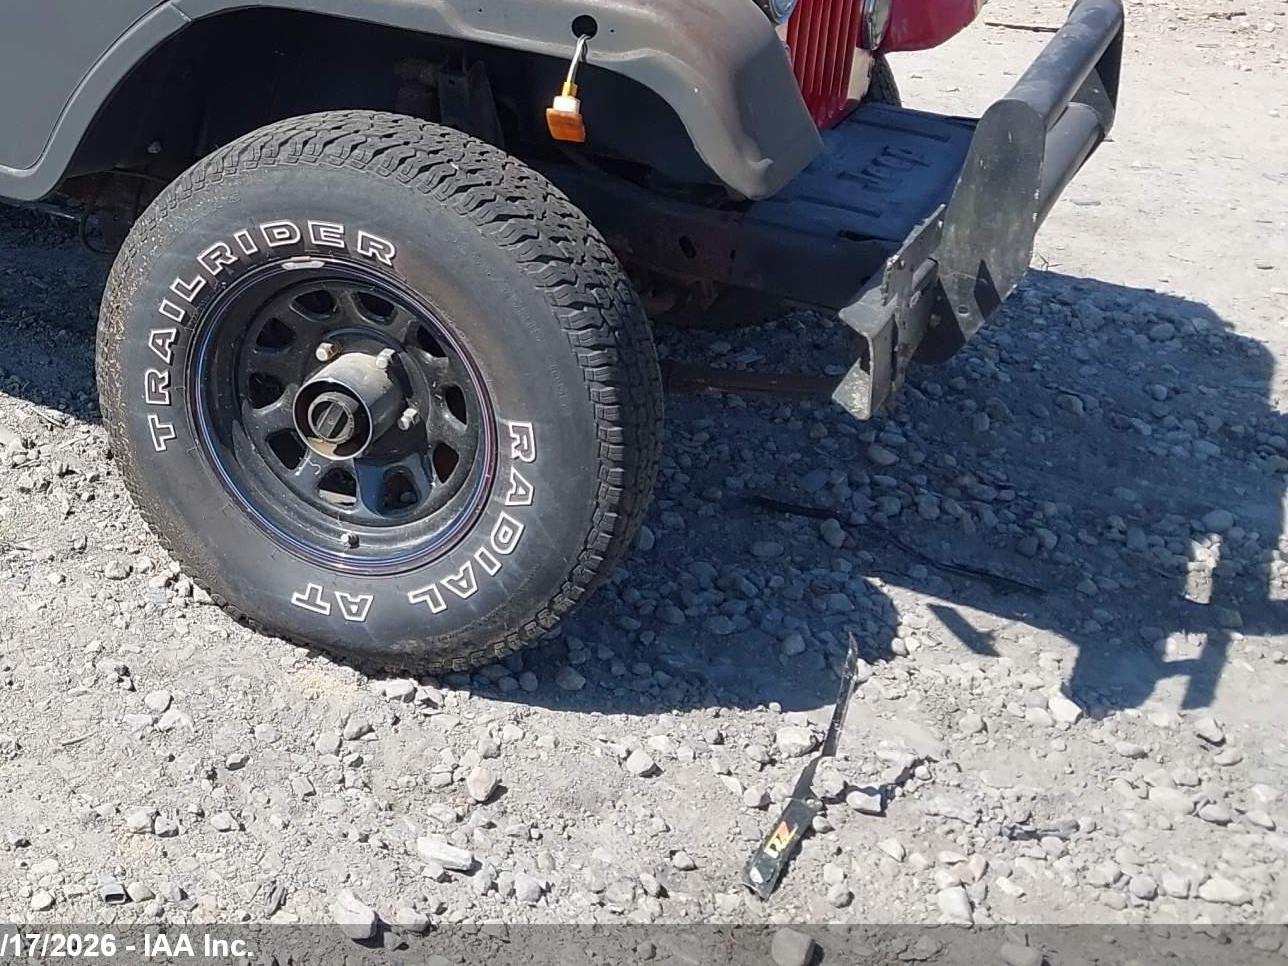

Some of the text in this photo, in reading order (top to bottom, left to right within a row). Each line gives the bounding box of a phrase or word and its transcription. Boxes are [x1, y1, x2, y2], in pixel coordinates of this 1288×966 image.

[143, 219, 396, 452] TRAILRIDER
[291, 420, 537, 623] RADIAL AT
